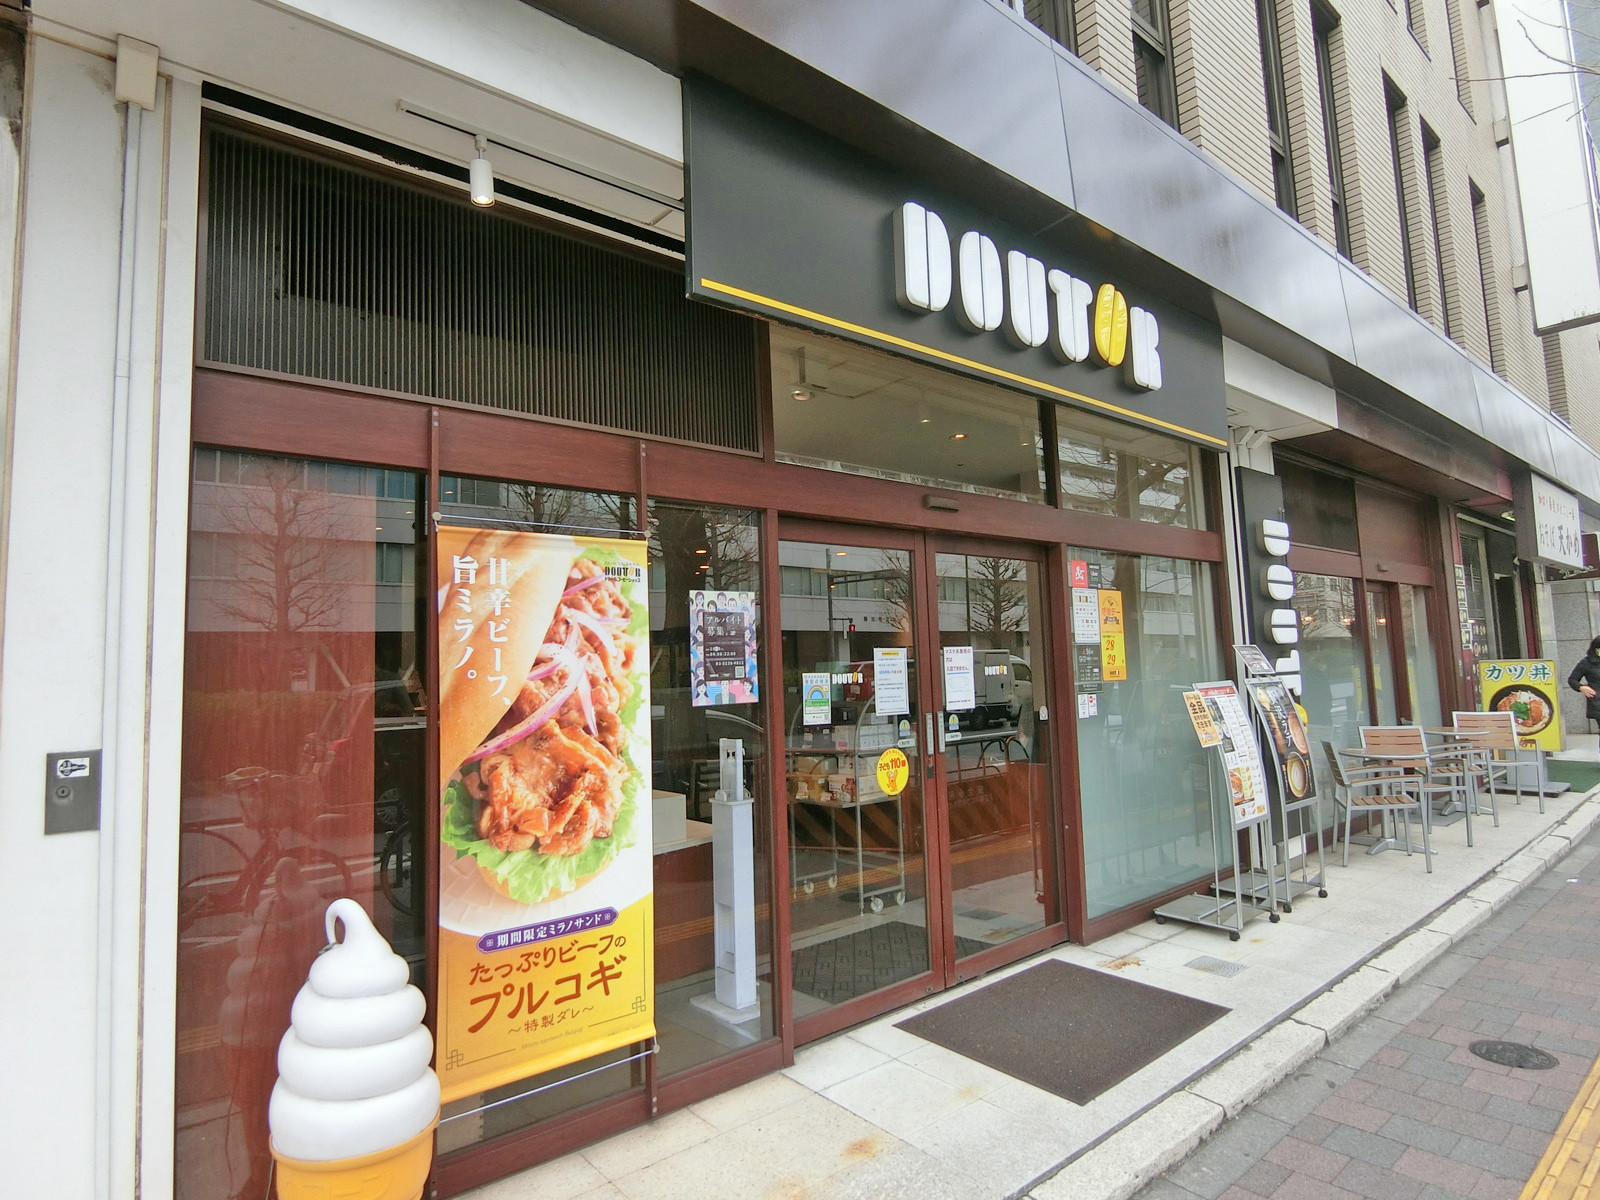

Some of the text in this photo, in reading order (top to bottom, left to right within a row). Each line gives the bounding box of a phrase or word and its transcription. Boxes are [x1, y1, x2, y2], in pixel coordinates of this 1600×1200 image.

[893, 201, 1162, 391] DOUTOR
[452, 555, 477, 681] 旨ミラノ。
[486, 557, 511, 706] 甘辛ビーフ、
[706, 615, 742, 625] アルバイト
[1105, 639, 1115, 651] 28
[984, 664, 1008, 676] DOUTOR
[1107, 653, 1116, 666] 29
[1484, 662, 1552, 682] カツ丼
[831, 671, 863, 685] DOUTOR
[496, 913, 602, 948] 期間限定ミラノサンド
[469, 934, 627, 986] たっぷりビーフの
[467, 955, 627, 1034] プルコギ
